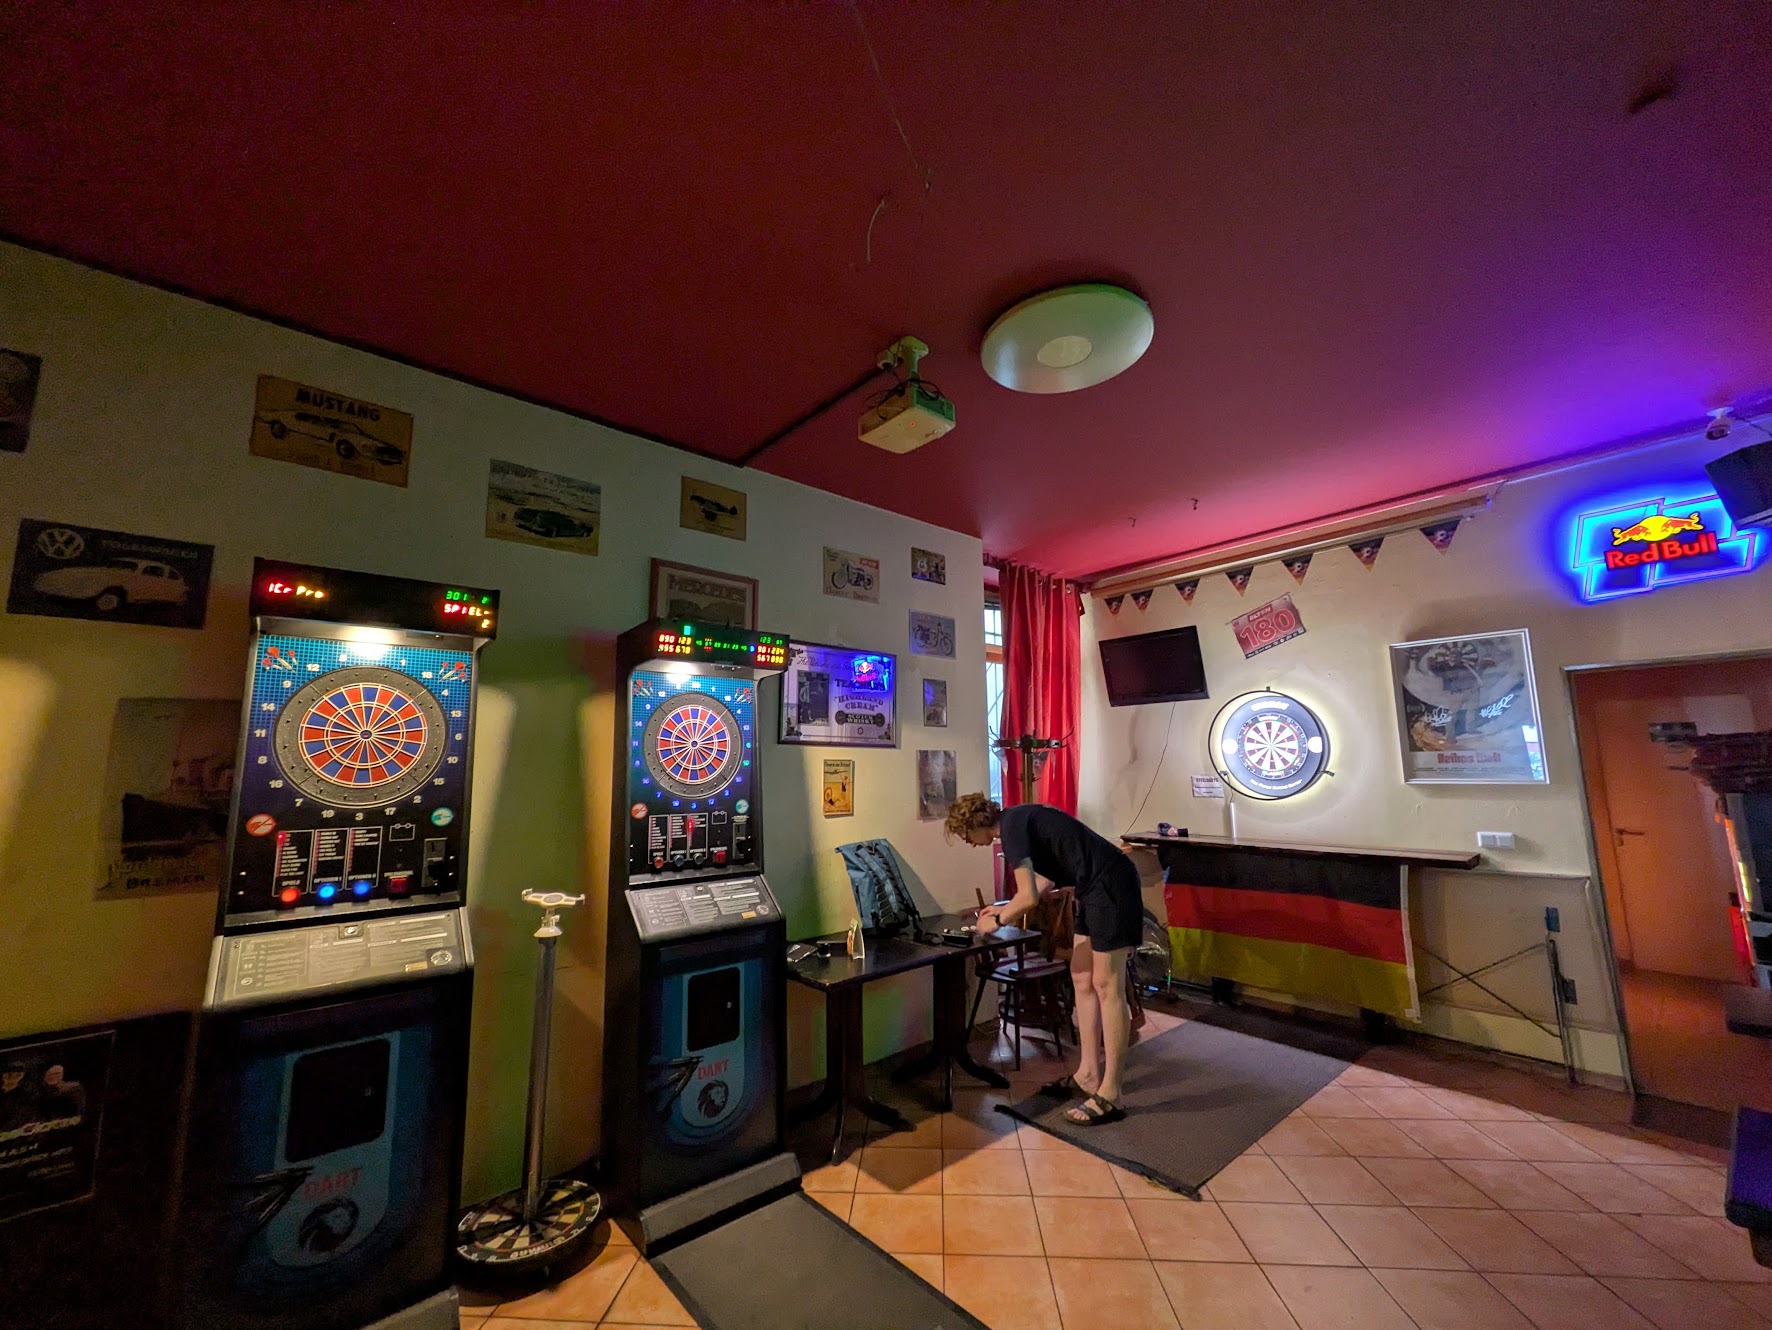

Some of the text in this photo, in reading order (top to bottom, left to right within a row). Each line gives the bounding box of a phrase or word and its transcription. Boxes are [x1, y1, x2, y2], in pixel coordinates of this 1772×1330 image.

[296, 388, 381, 421] MUSTANG
[1606, 532, 1718, 570] Red Bull
[446, 591, 468, 601] 301
[1240, 608, 1296, 648] 180
[306, 664, 320, 672] 12
[421, 671, 433, 680] 18
[283, 680, 291, 688] 9
[261, 703, 275, 712] 14
[254, 729, 266, 737] 11
[454, 732, 462, 740] 6
[258, 756, 267, 764] 8
[269, 780, 283, 788] 16
[413, 796, 422, 804] 2
[321, 810, 335, 818] 19
[385, 807, 396, 816] 17
